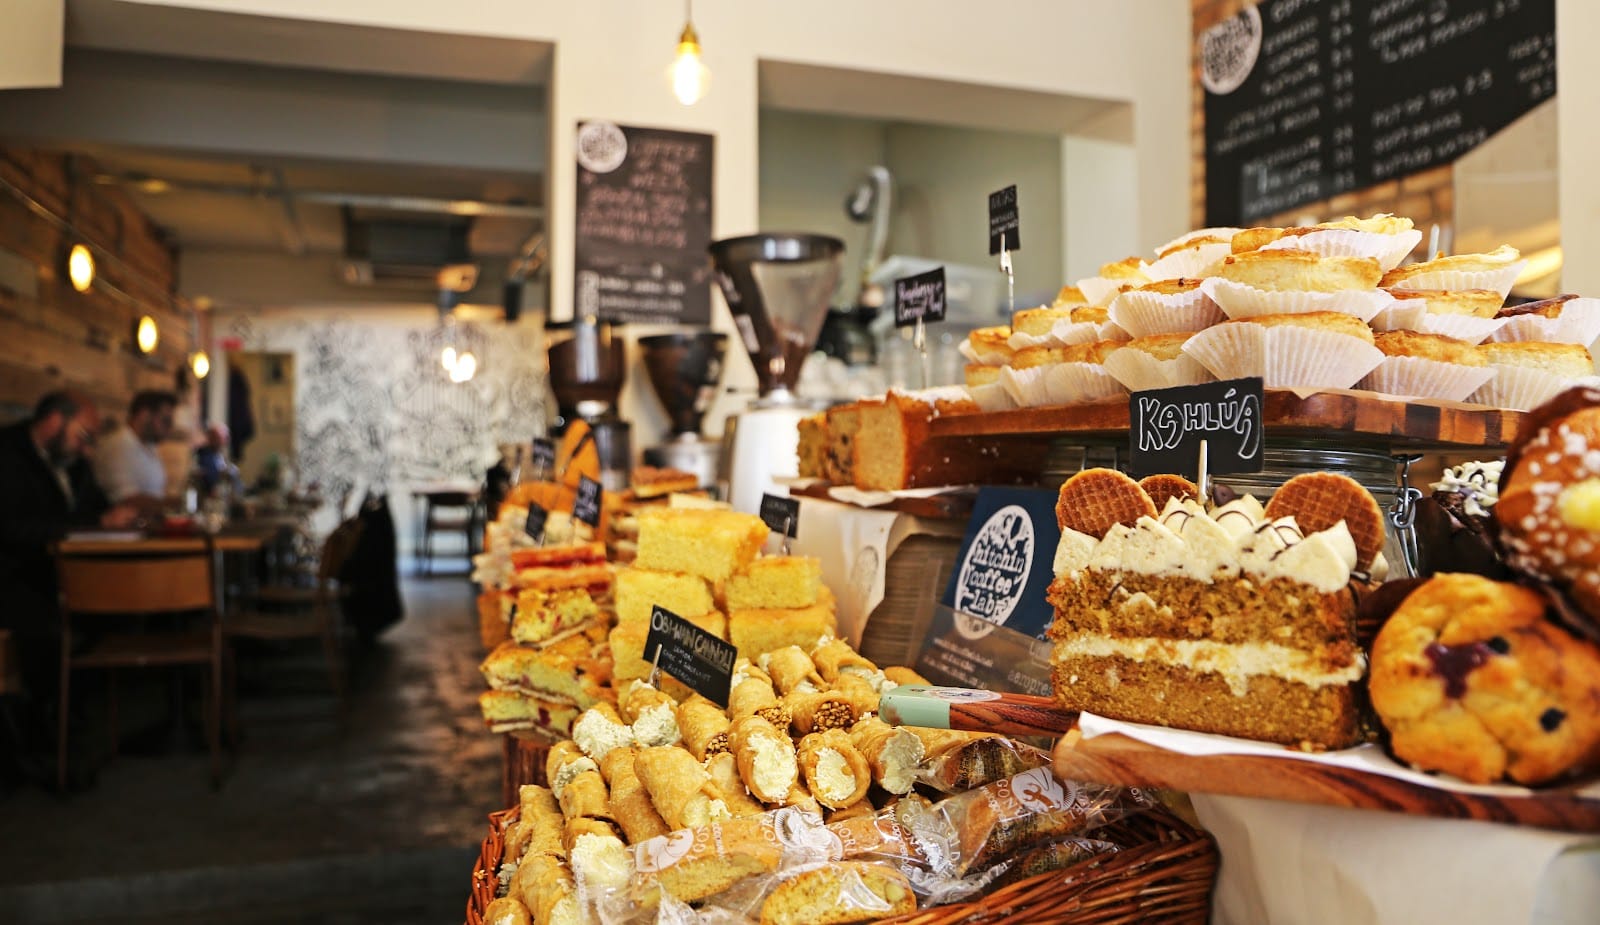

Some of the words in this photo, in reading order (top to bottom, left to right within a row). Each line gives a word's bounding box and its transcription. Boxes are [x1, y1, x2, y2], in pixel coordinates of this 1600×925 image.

[1139, 388, 1260, 459] KAHLÚA
[972, 542, 1025, 574] hitchin
[969, 568, 1013, 595] coffee
[969, 589, 995, 615] lab
[1007, 669, 1054, 697] aeropres
